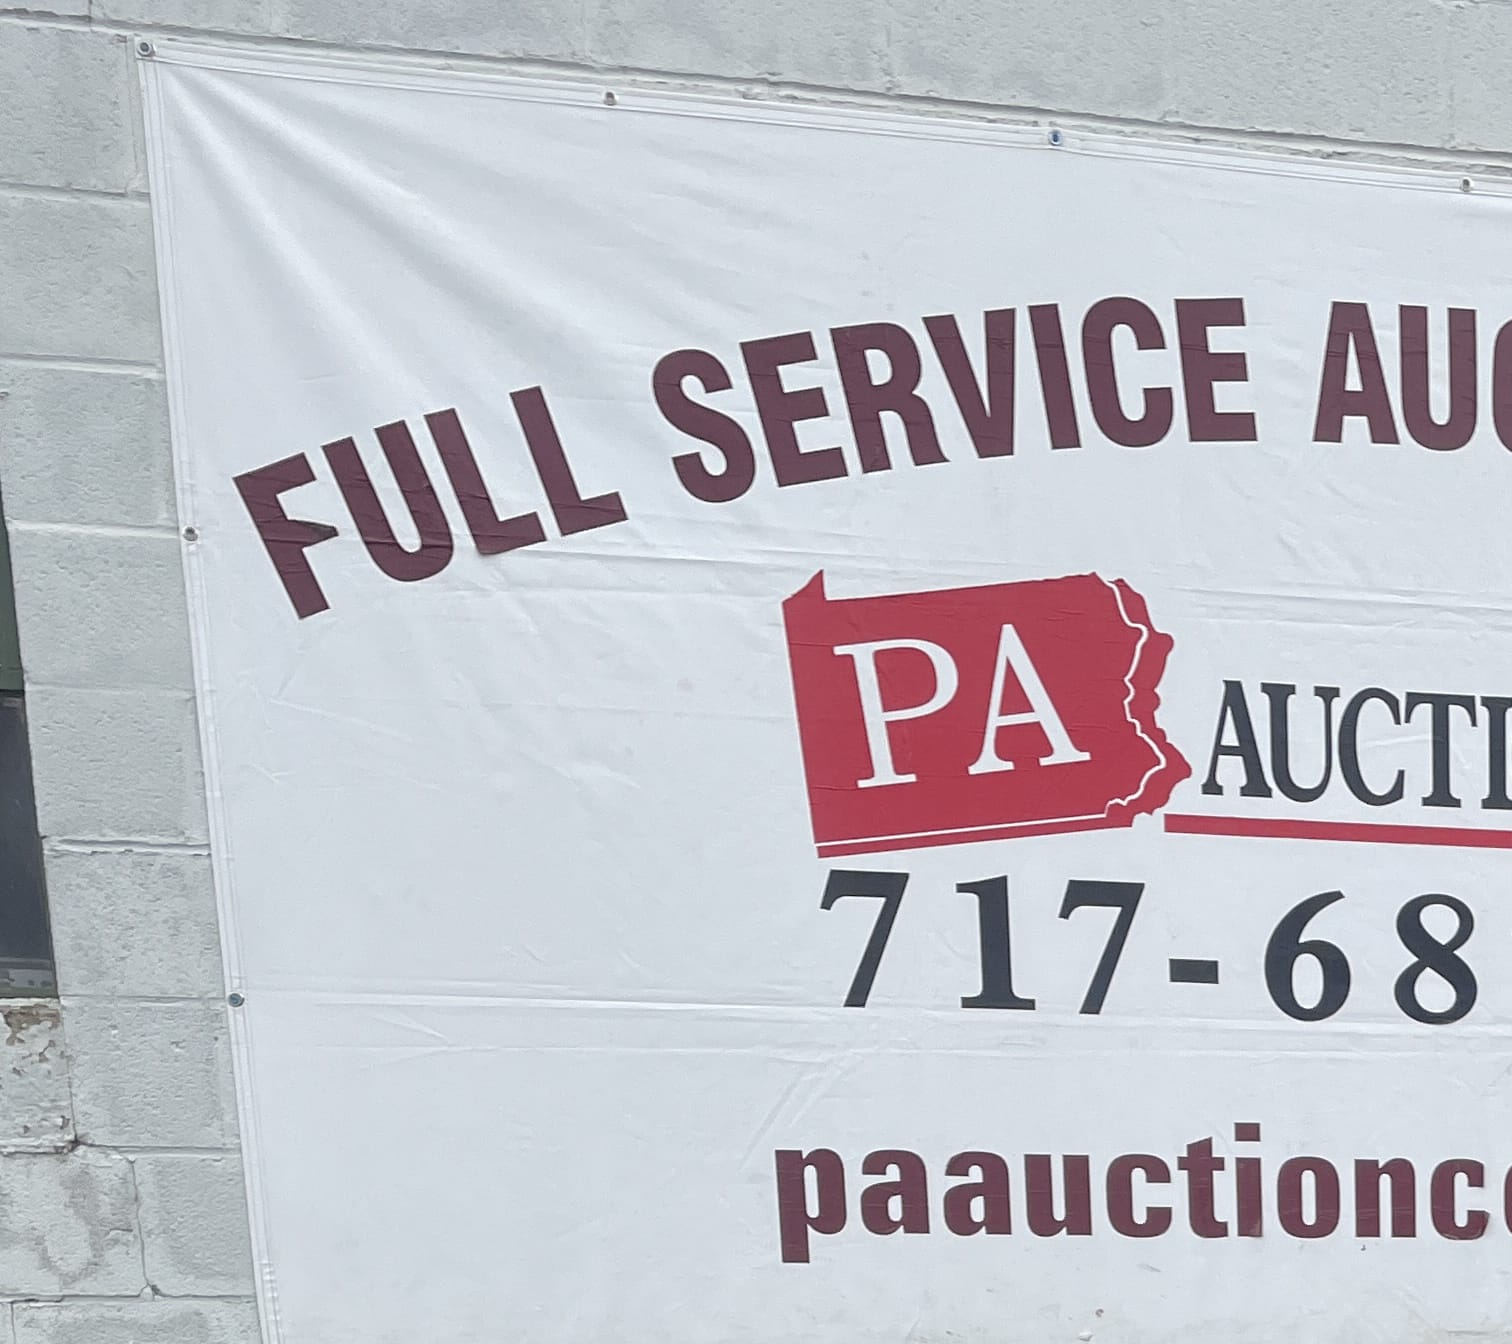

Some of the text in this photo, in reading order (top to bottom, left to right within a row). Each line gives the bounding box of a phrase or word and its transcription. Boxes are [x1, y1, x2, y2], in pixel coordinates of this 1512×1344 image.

[233, 385, 628, 620] FULL
[652, 296, 1258, 504] SERVICE
[834, 624, 1091, 788] PA
